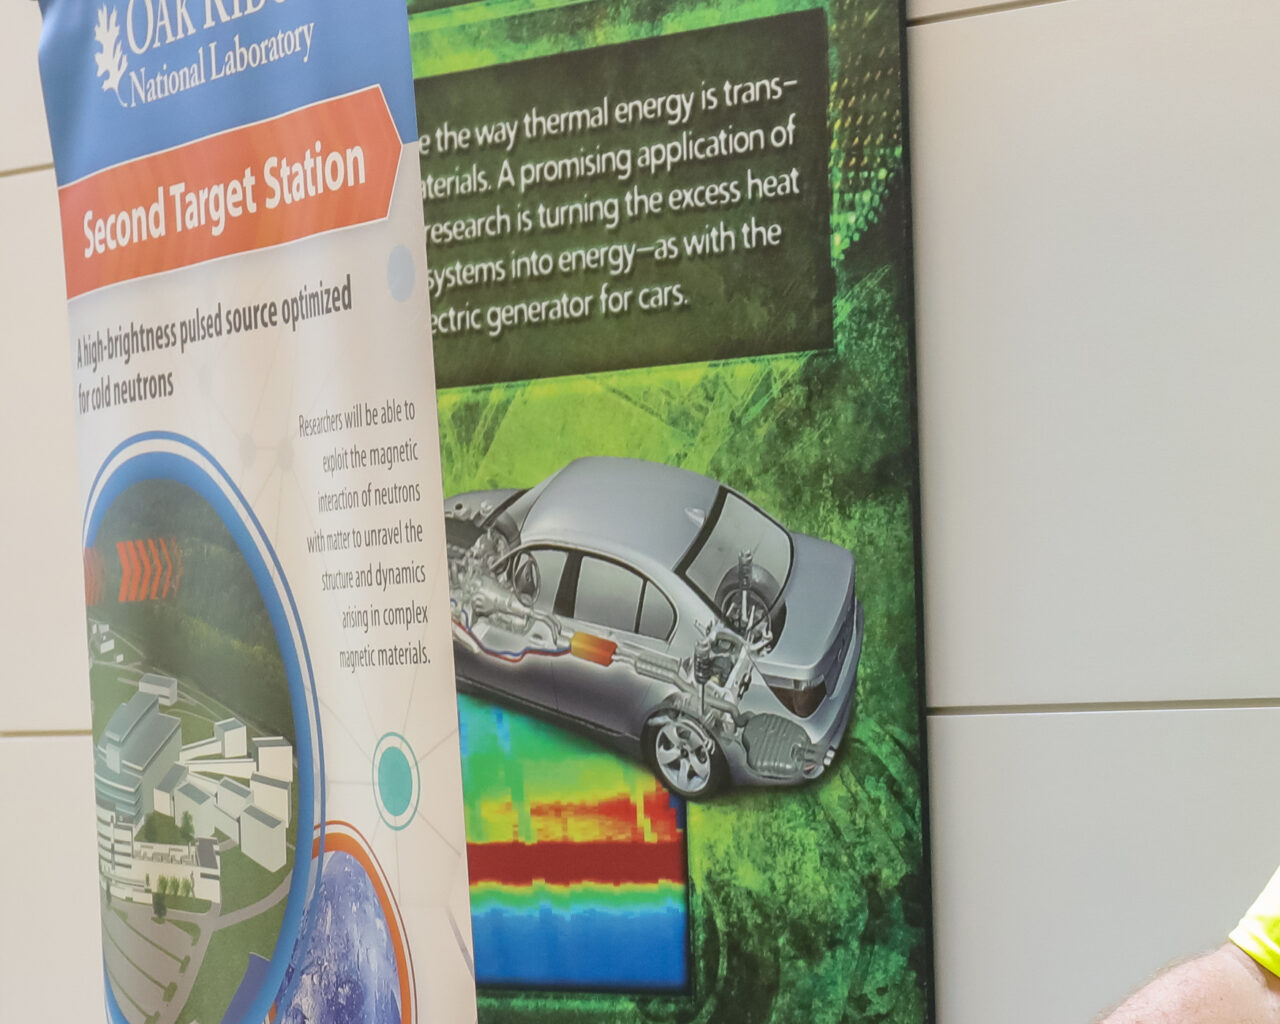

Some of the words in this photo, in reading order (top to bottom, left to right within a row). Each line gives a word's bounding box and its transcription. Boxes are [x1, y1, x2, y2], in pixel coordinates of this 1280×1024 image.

[129, 46, 206, 108] National
[209, 22, 315, 80] Laboratory
[435, 122, 471, 153] the
[475, 115, 519, 151] way
[523, 96, 609, 139] thermal
[615, 90, 694, 126] energy
[700, 80, 719, 109] is
[497, 159, 516, 189] A
[520, 144, 632, 193] promising
[637, 122, 764, 170] application
[770, 113, 797, 148] of
[83, 186, 167, 259] Second
[169, 166, 258, 237] Target
[263, 140, 366, 210] Station
[425, 203, 510, 244] research
[516, 207, 533, 232] is
[538, 194, 620, 231] turning
[624, 185, 663, 218] the
[669, 178, 741, 211] excess
[747, 167, 801, 200] heat
[511, 249, 554, 278] into
[683, 222, 736, 258] with
[742, 216, 783, 250] the
[77, 337, 83, 369] A
[83, 321, 177, 373] high-brightness
[180, 302, 223, 353] pulsed
[226, 301, 278, 335] source
[282, 274, 352, 332] optimized
[486, 291, 593, 336] generator
[599, 282, 634, 314] for
[638, 282, 690, 310] cars.
[78, 383, 90, 415] for
[91, 375, 111, 411] cold
[113, 371, 174, 406] neutrons
[298, 410, 343, 438] Researchers
[345, 403, 363, 429] will
[365, 402, 379, 427] be
[381, 398, 402, 425] able
[404, 400, 416, 421] to
[322, 447, 349, 478] exploit
[350, 444, 367, 469] the
[369, 438, 419, 471] magnetic
[318, 488, 359, 513] interaction
[361, 482, 373, 507] of
[374, 483, 421, 506] neutrons
[307, 529, 326, 553] with
[326, 530, 351, 552] matter
[352, 528, 362, 548] to
[364, 520, 403, 547] unravel
[405, 518, 423, 543] the
[321, 569, 354, 592] structure
[355, 562, 373, 588] and
[375, 560, 426, 592] dynamics
[342, 605, 369, 634] arising
[370, 604, 381, 627] in
[383, 600, 429, 631] complex
[339, 644, 376, 673] magnetic
[377, 640, 431, 667] materials.
